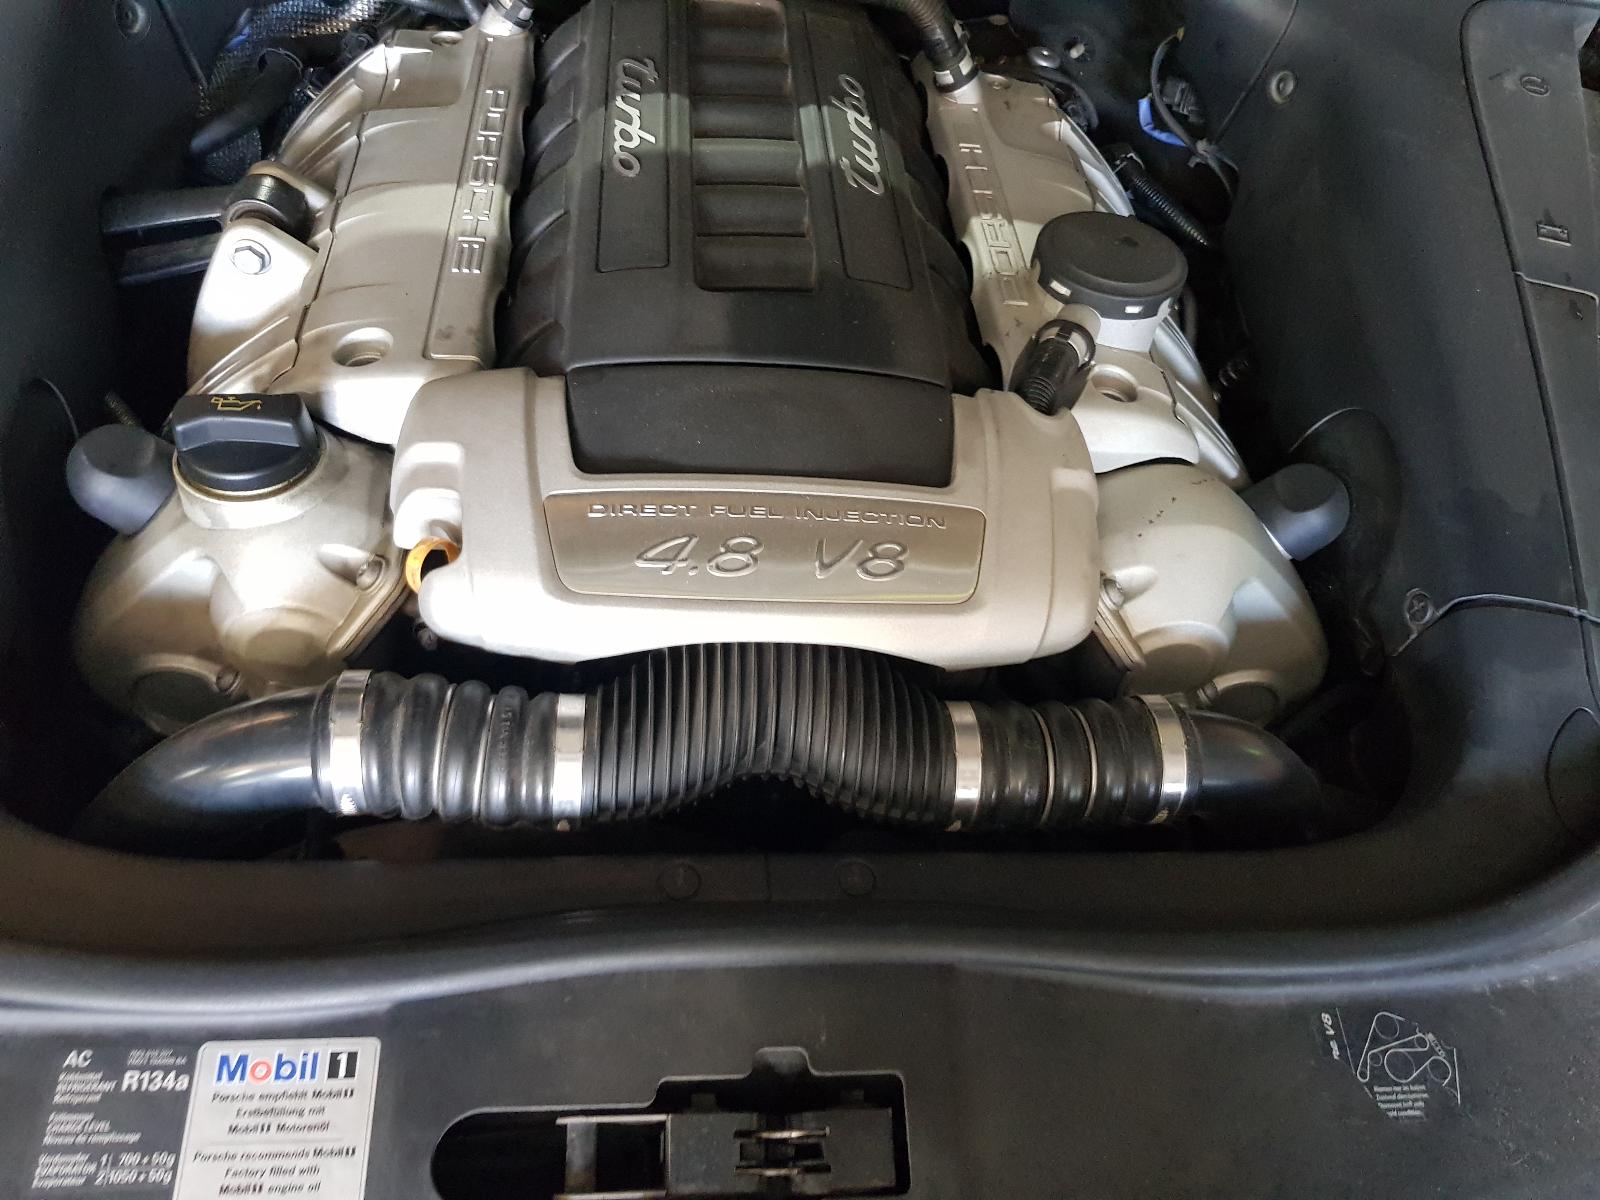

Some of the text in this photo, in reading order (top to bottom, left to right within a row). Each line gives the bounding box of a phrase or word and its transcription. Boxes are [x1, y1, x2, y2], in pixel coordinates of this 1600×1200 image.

[451, 89, 510, 274] PORSCHE
[587, 503, 947, 530] DIRECT FUEL INJECTION
[635, 533, 909, 582] 4.8 V8
[63, 1049, 93, 1069] AC
[215, 1052, 320, 1082] Mobil
[121, 1070, 190, 1092] R134a
[212, 1091, 255, 1103] Porsche
[193, 1150, 237, 1163] Porsche
[240, 1149, 310, 1162] recommends
[225, 1164, 320, 1180] Factory filled with
[267, 1184, 304, 1195] engine
[307, 1182, 321, 1193] oil
